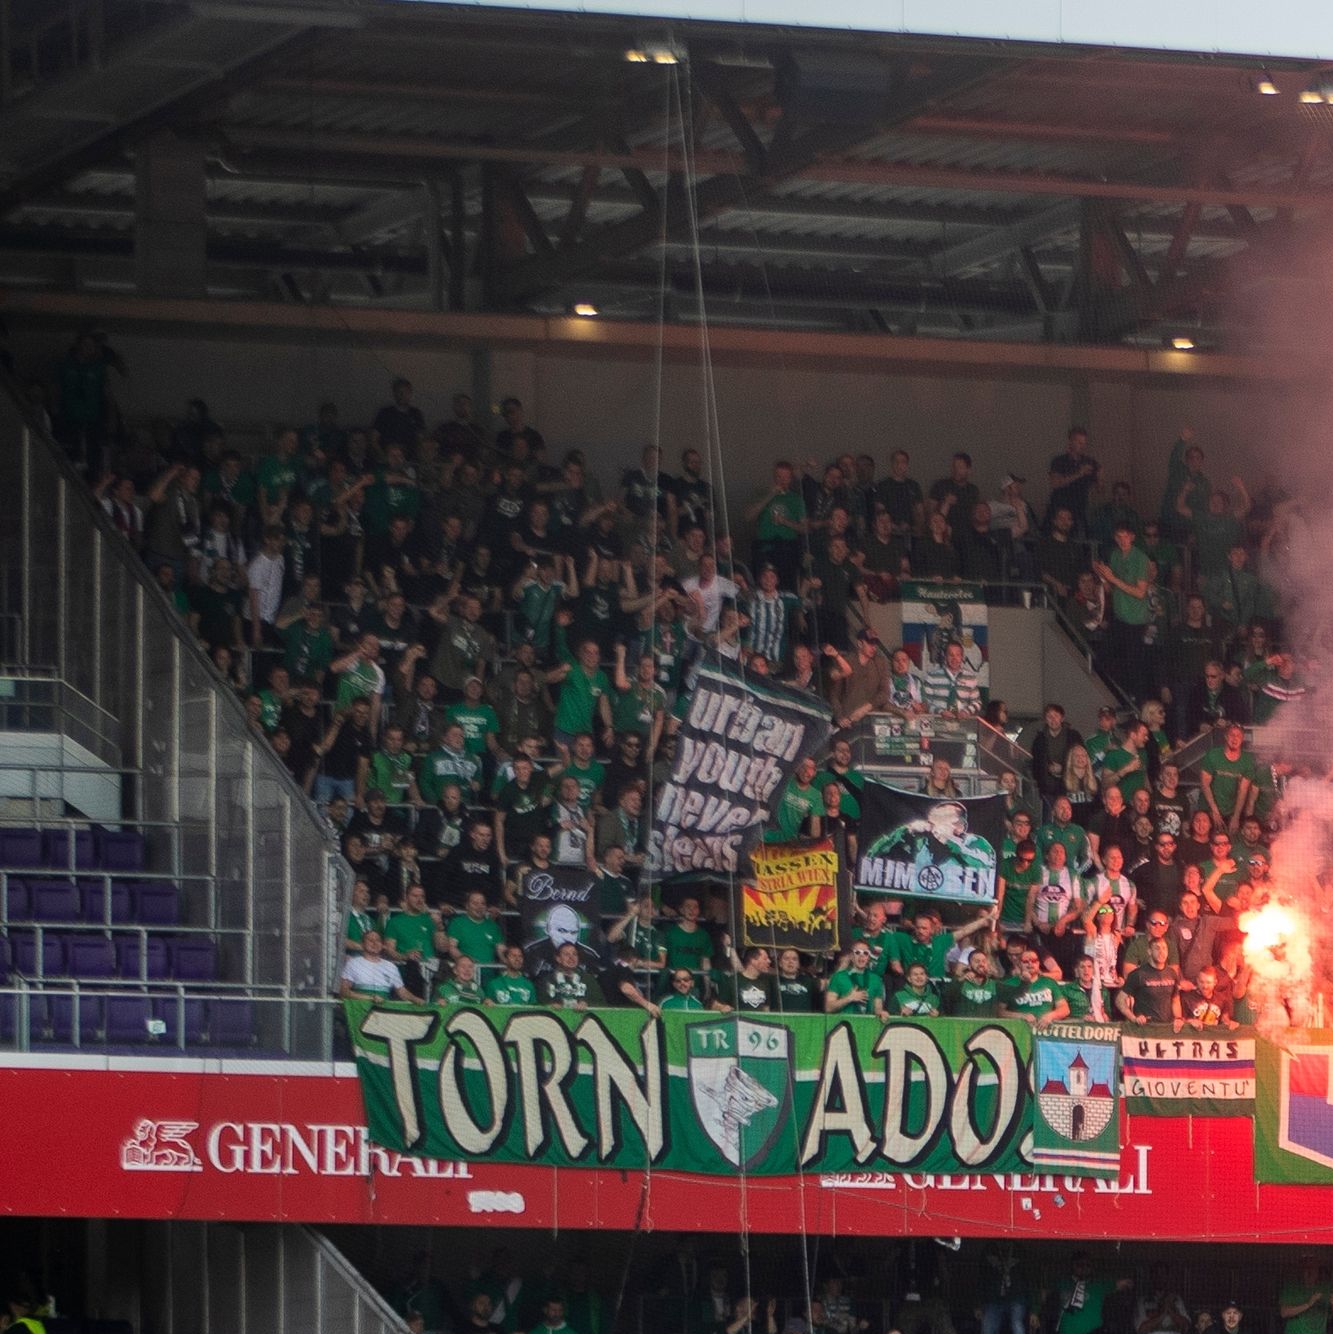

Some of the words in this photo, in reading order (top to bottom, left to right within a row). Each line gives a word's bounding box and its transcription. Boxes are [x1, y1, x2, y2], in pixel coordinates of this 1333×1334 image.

[687, 685, 806, 763] urban
[671, 735, 786, 801] youth
[527, 873, 594, 902] Bernd
[859, 857, 996, 900] MIMSEN
[696, 1028, 731, 1050] TR
[747, 1029, 781, 1051] 96
[1033, 1023, 1123, 1042] TTELDORF
[1138, 1040, 1239, 1060] ULTRAS
[362, 1008, 667, 1166] TORN
[800, 1020, 1038, 1171] ADO
